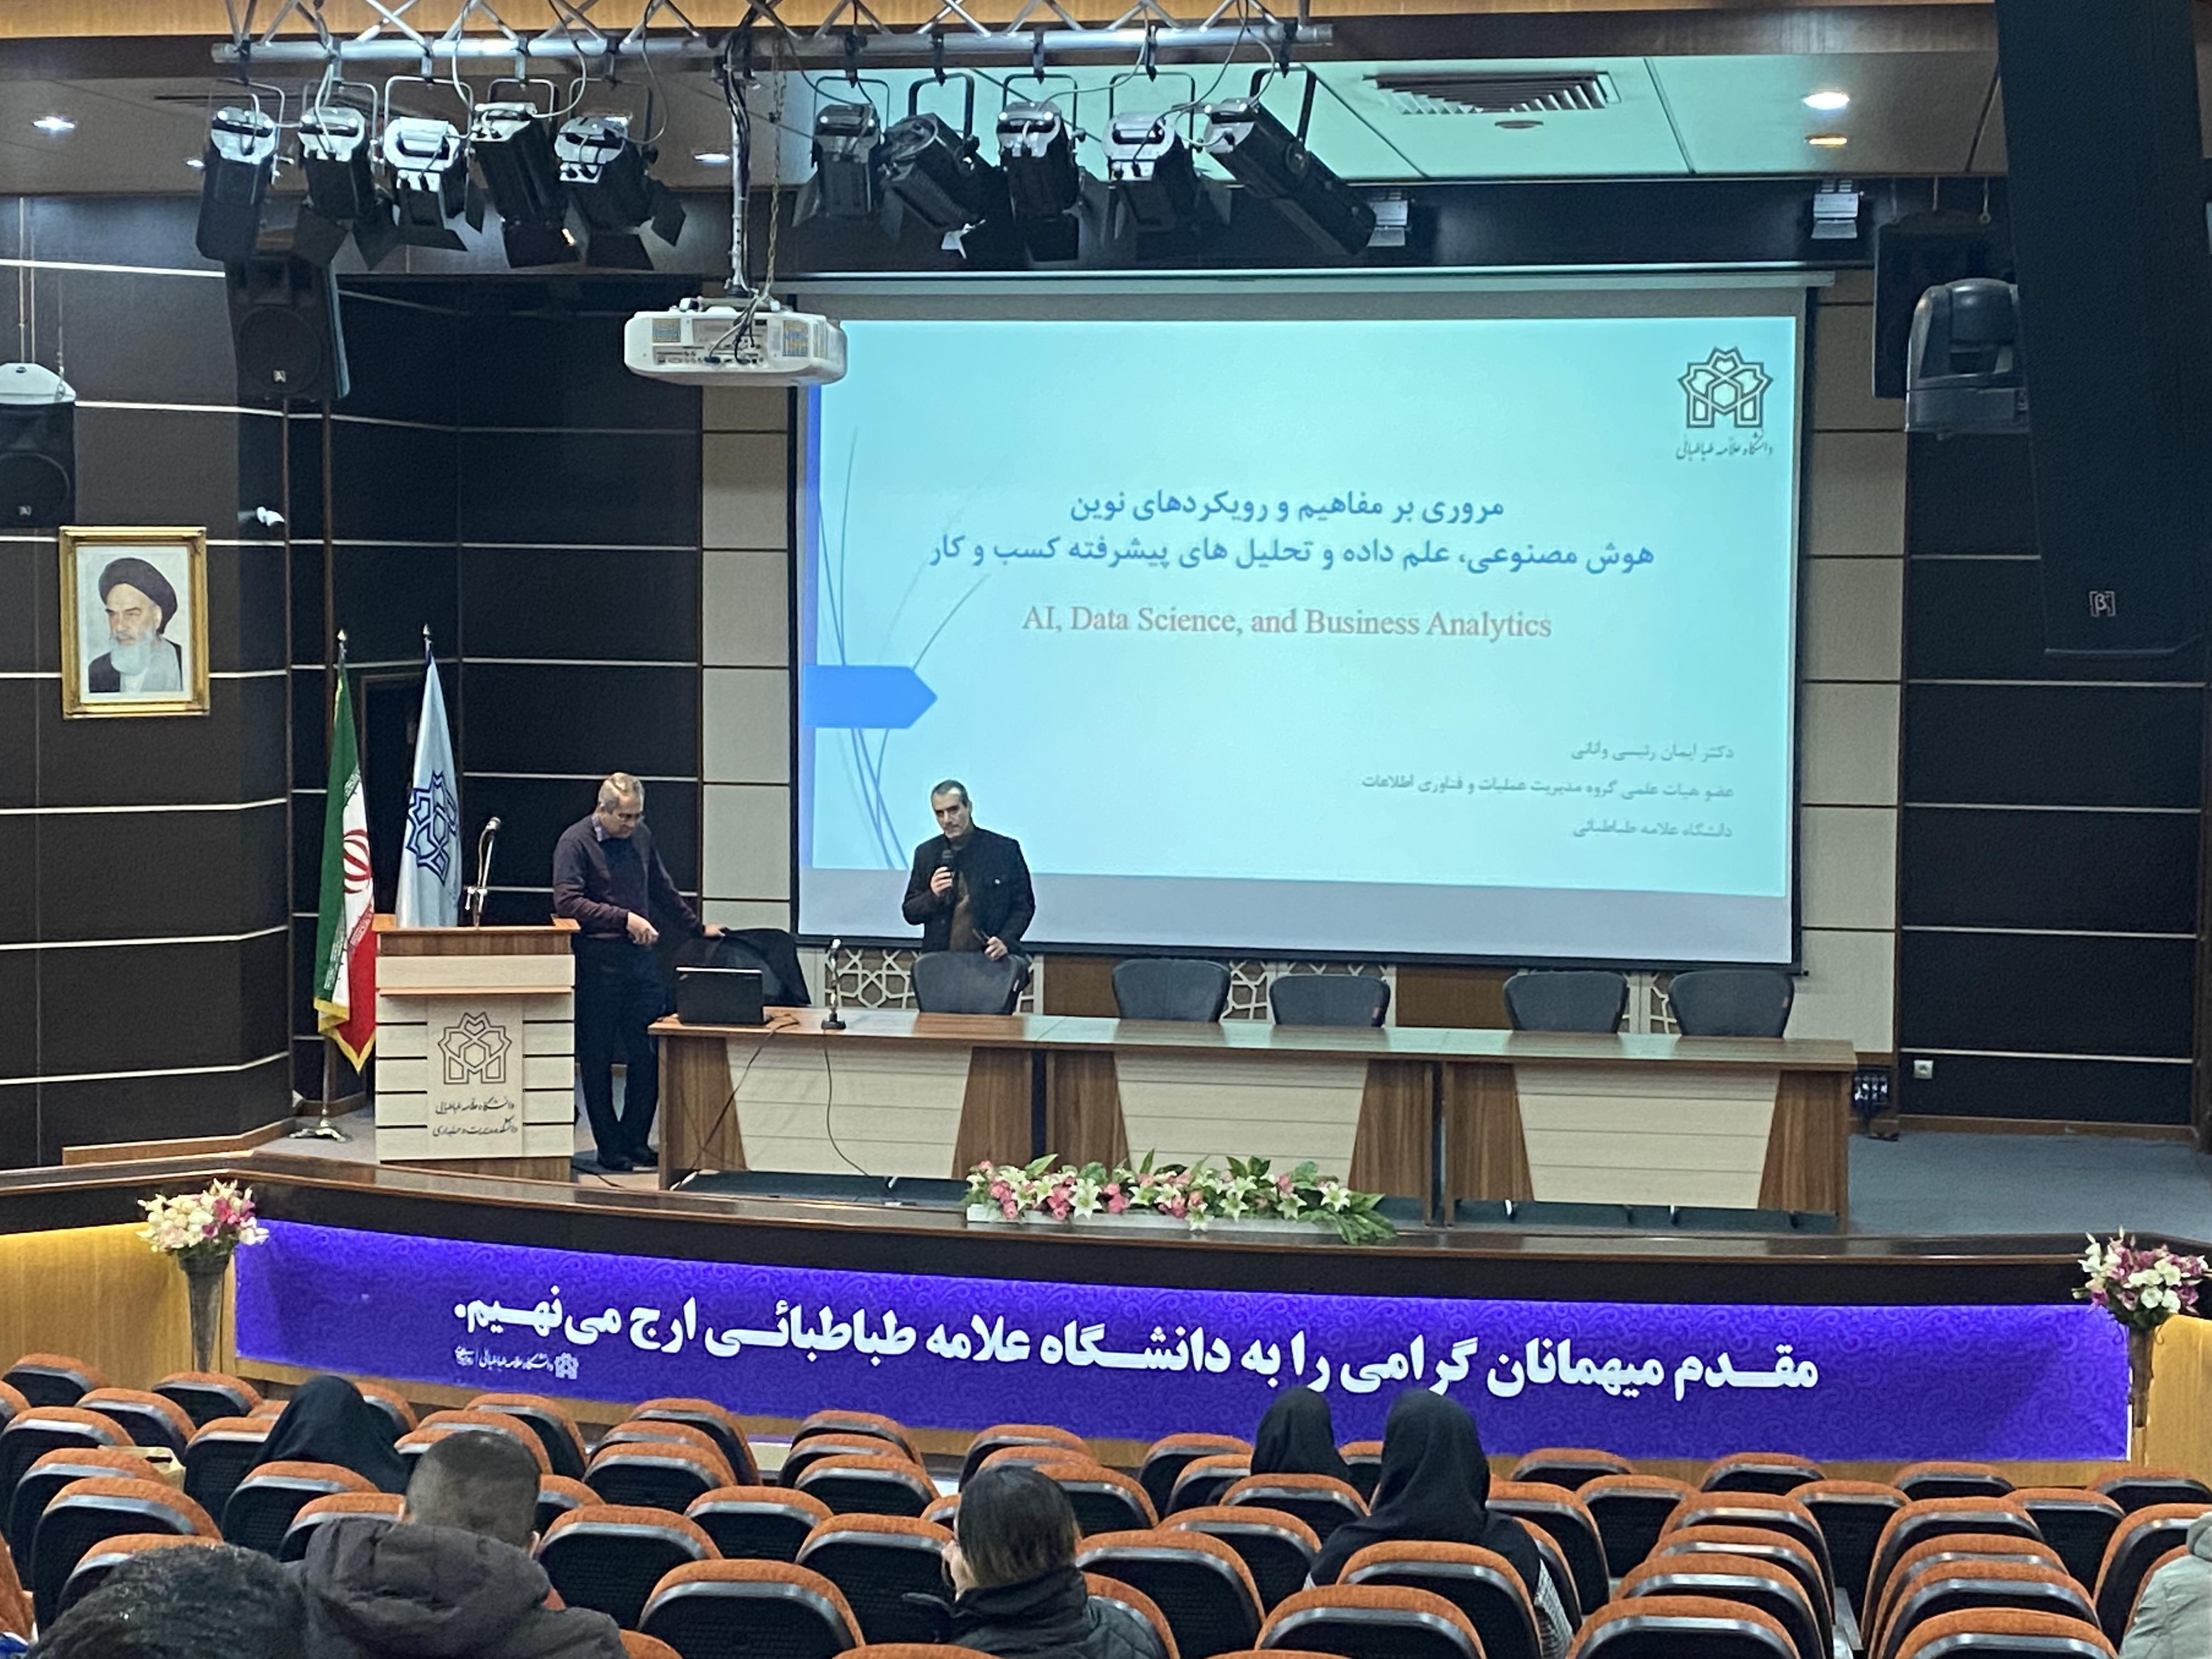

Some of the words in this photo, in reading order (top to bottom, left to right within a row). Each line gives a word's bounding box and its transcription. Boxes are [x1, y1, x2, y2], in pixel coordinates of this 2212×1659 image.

[1070, 491, 1125, 522] نوین
[1132, 489, 1268, 523] رویکردهای
[1276, 501, 1289, 523] و
[1298, 490, 1383, 522] مفاهیم
[1391, 501, 1414, 524] بر
[1421, 501, 1504, 524] مروری
[929, 533, 966, 567] کار
[972, 544, 984, 567] و
[993, 536, 1061, 566] کسب
[1068, 535, 1169, 569] پیشرفته
[1178, 537, 1228, 569] های
[1235, 538, 1314, 569] تحلیل
[1322, 549, 1334, 571] و
[1342, 538, 1394, 562] داده
[1402, 539, 1450, 571] علم
[1585, 542, 1655, 574] هوش
[1021, 605, 1063, 633] AI,
[1070, 606, 1130, 630] Data
[1137, 606, 1243, 636] Science,
[1250, 607, 1298, 633] and
[1304, 608, 1420, 635] Business
[1425, 610, 1552, 644] Analytics
[1661, 743, 1697, 761] ایمان
[1701, 744, 1735, 763] دکتر
[1361, 774, 1414, 788] اطلاعات
[1417, 775, 1463, 794] فناوری
[1468, 783, 1475, 795] و
[1478, 777, 1527, 794] عملیات
[1530, 781, 1583, 797] مدیریت
[1585, 779, 1618, 798] گروه
[1621, 782, 1658, 800] علمی
[1705, 788, 1734, 802] عضو
[1640, 822, 1679, 836] علامه
[1681, 822, 1733, 838] دانشگاه
[630, 1295, 696, 1353] ارج
[704, 1300, 917, 1367] طباطبائی
[926, 1314, 1031, 1362] علامه
[1040, 1319, 1231, 1373] دانشگاه
[1290, 1330, 1330, 1392] را
[1241, 1339, 1281, 1388] به
[1340, 1334, 1479, 1396] گرامی
[1487, 1338, 1664, 1398] میهمانان
[1674, 1344, 1819, 1401] مقدم
